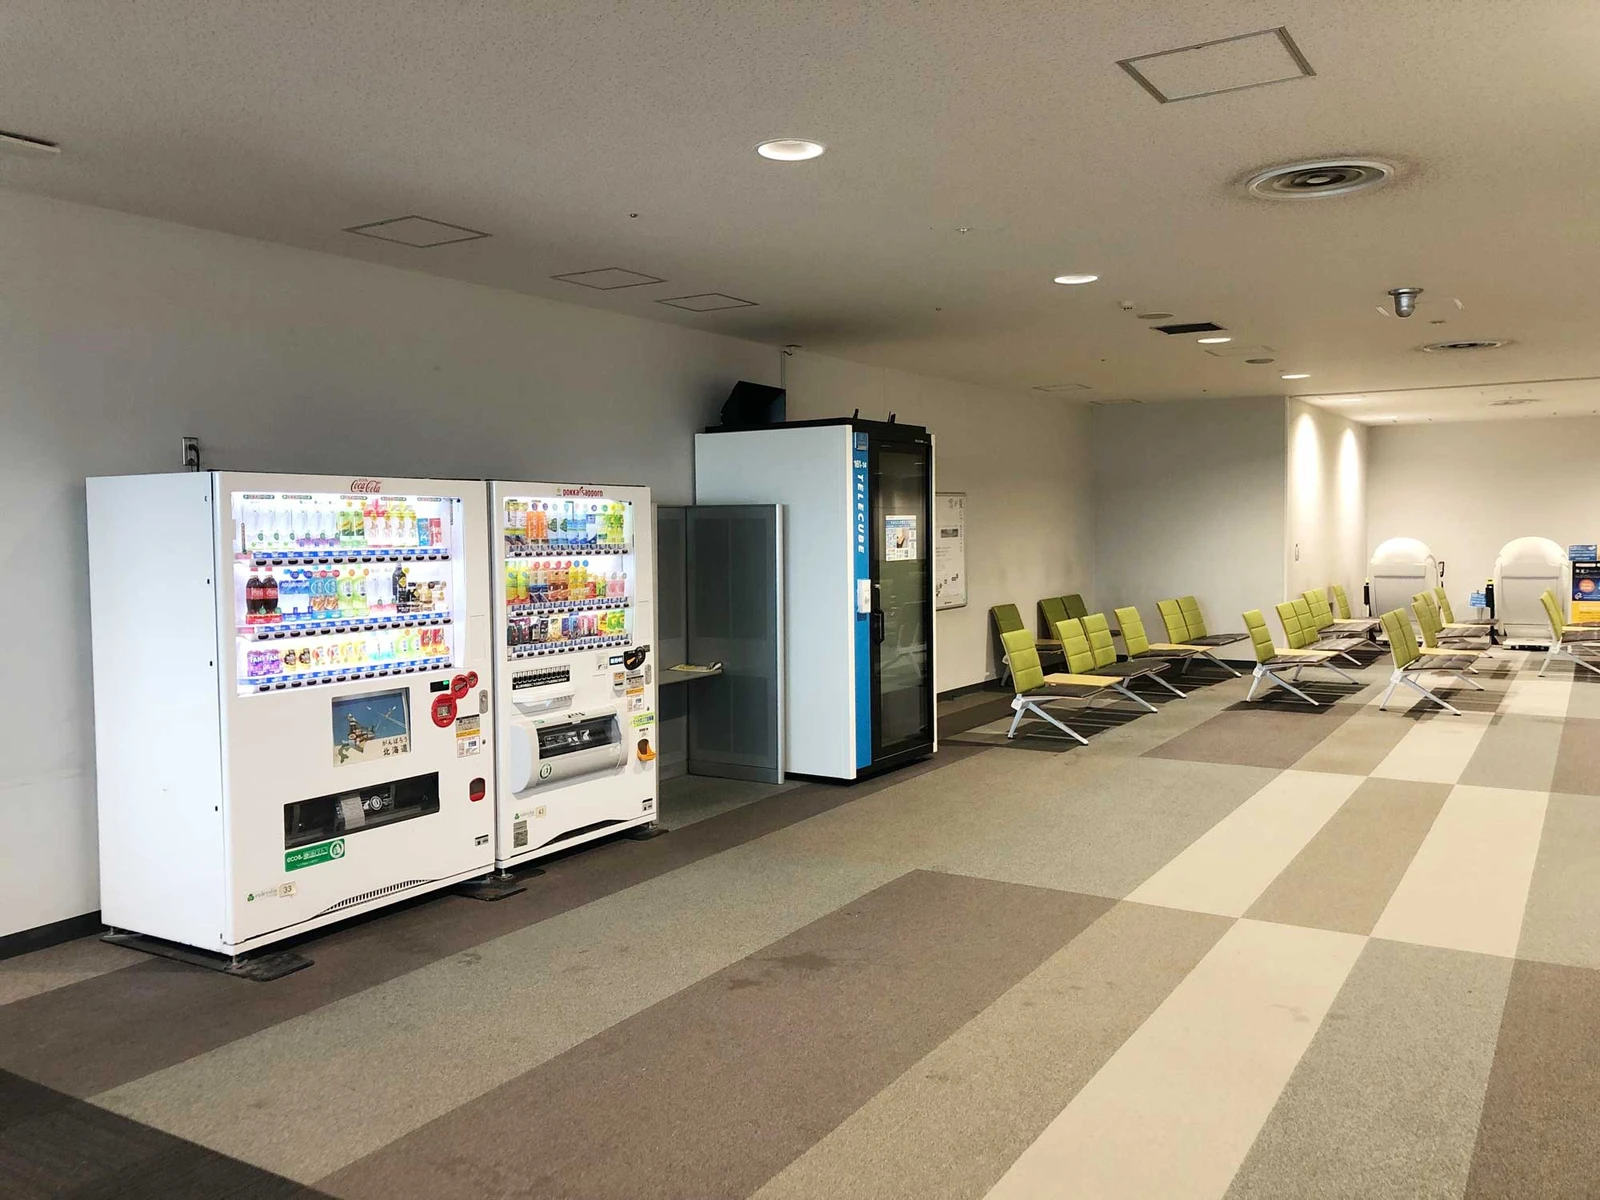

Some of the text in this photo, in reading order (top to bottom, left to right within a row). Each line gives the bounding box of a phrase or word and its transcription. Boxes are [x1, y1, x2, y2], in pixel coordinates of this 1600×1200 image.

[857, 474, 866, 554] TELECUBE
[383, 744, 408, 756] 北海道
[283, 884, 293, 894] 33
